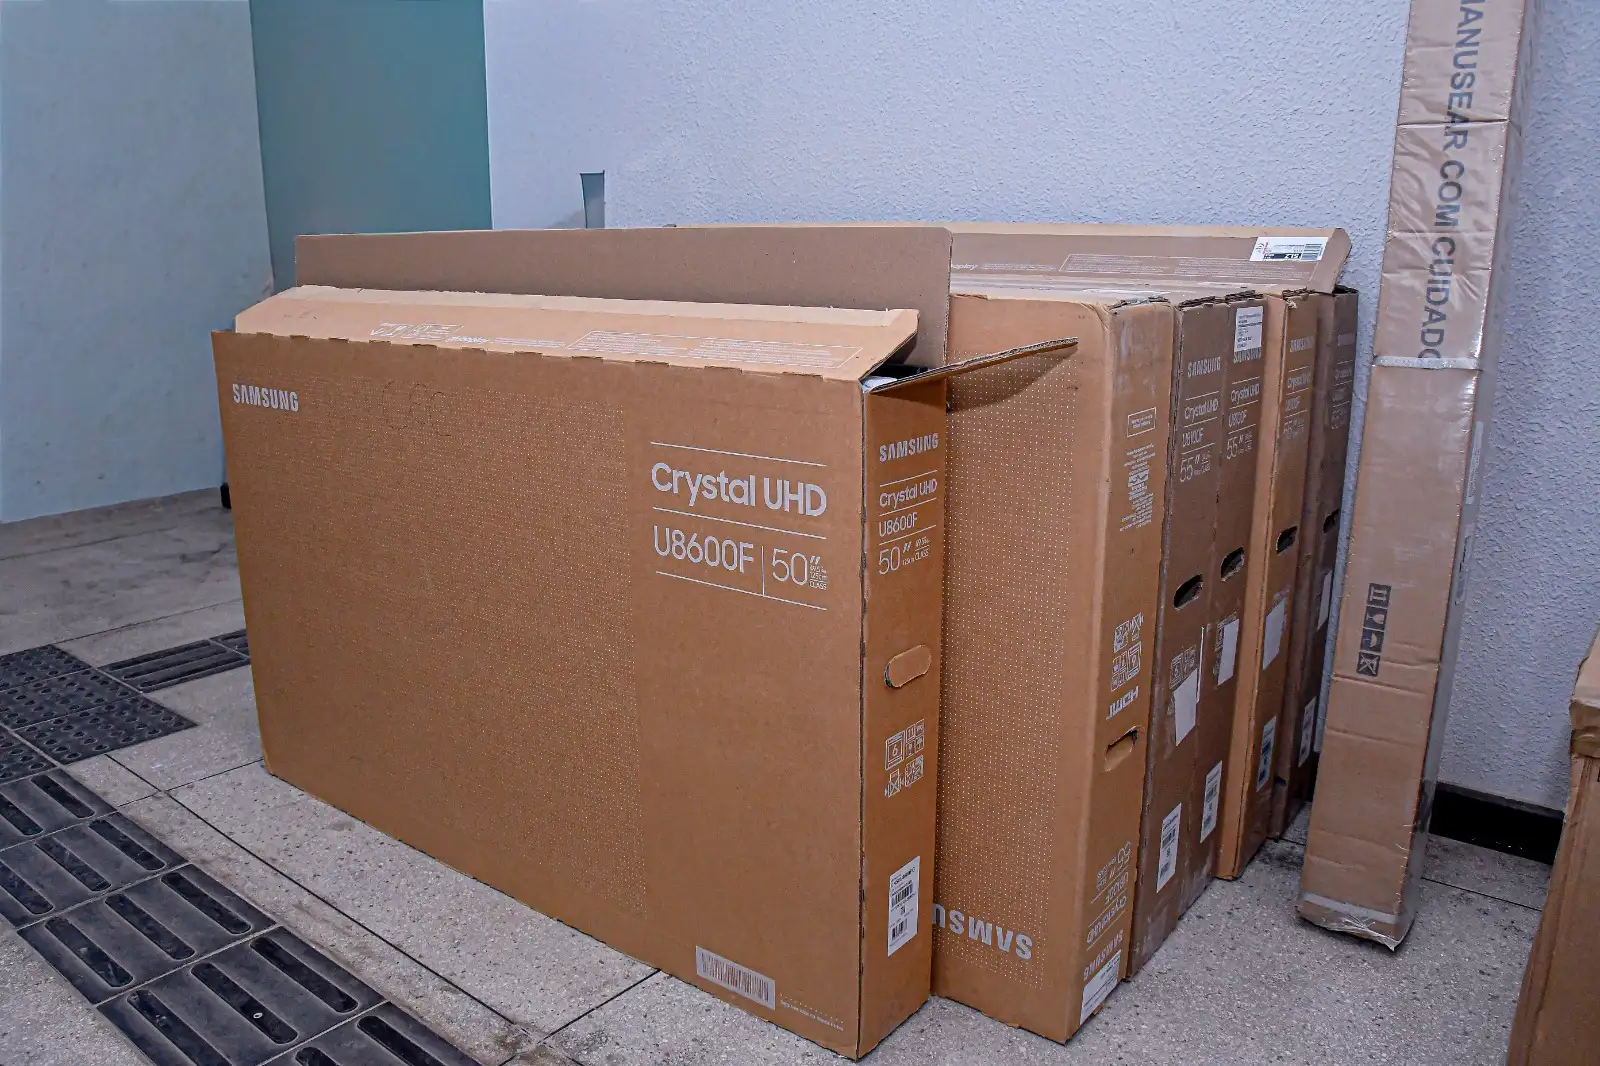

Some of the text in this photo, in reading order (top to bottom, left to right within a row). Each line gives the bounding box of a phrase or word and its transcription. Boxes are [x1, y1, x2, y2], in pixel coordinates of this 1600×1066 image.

[1442, 0, 1485, 151] ANUSEAR
[1434, 160, 1465, 226] COM
[1187, 356, 1221, 378] SAMSUNG
[232, 383, 299, 412] SAMSUNG
[1184, 400, 1207, 423] Crystal
[879, 432, 939, 462] SAMSUNG
[651, 462, 827, 517] Crystal UHD
[879, 478, 938, 510] Crystal UHD
[879, 511, 918, 537] U8600F
[653, 525, 754, 574] U8600F
[1083, 929, 1124, 982] SAMSUNG
